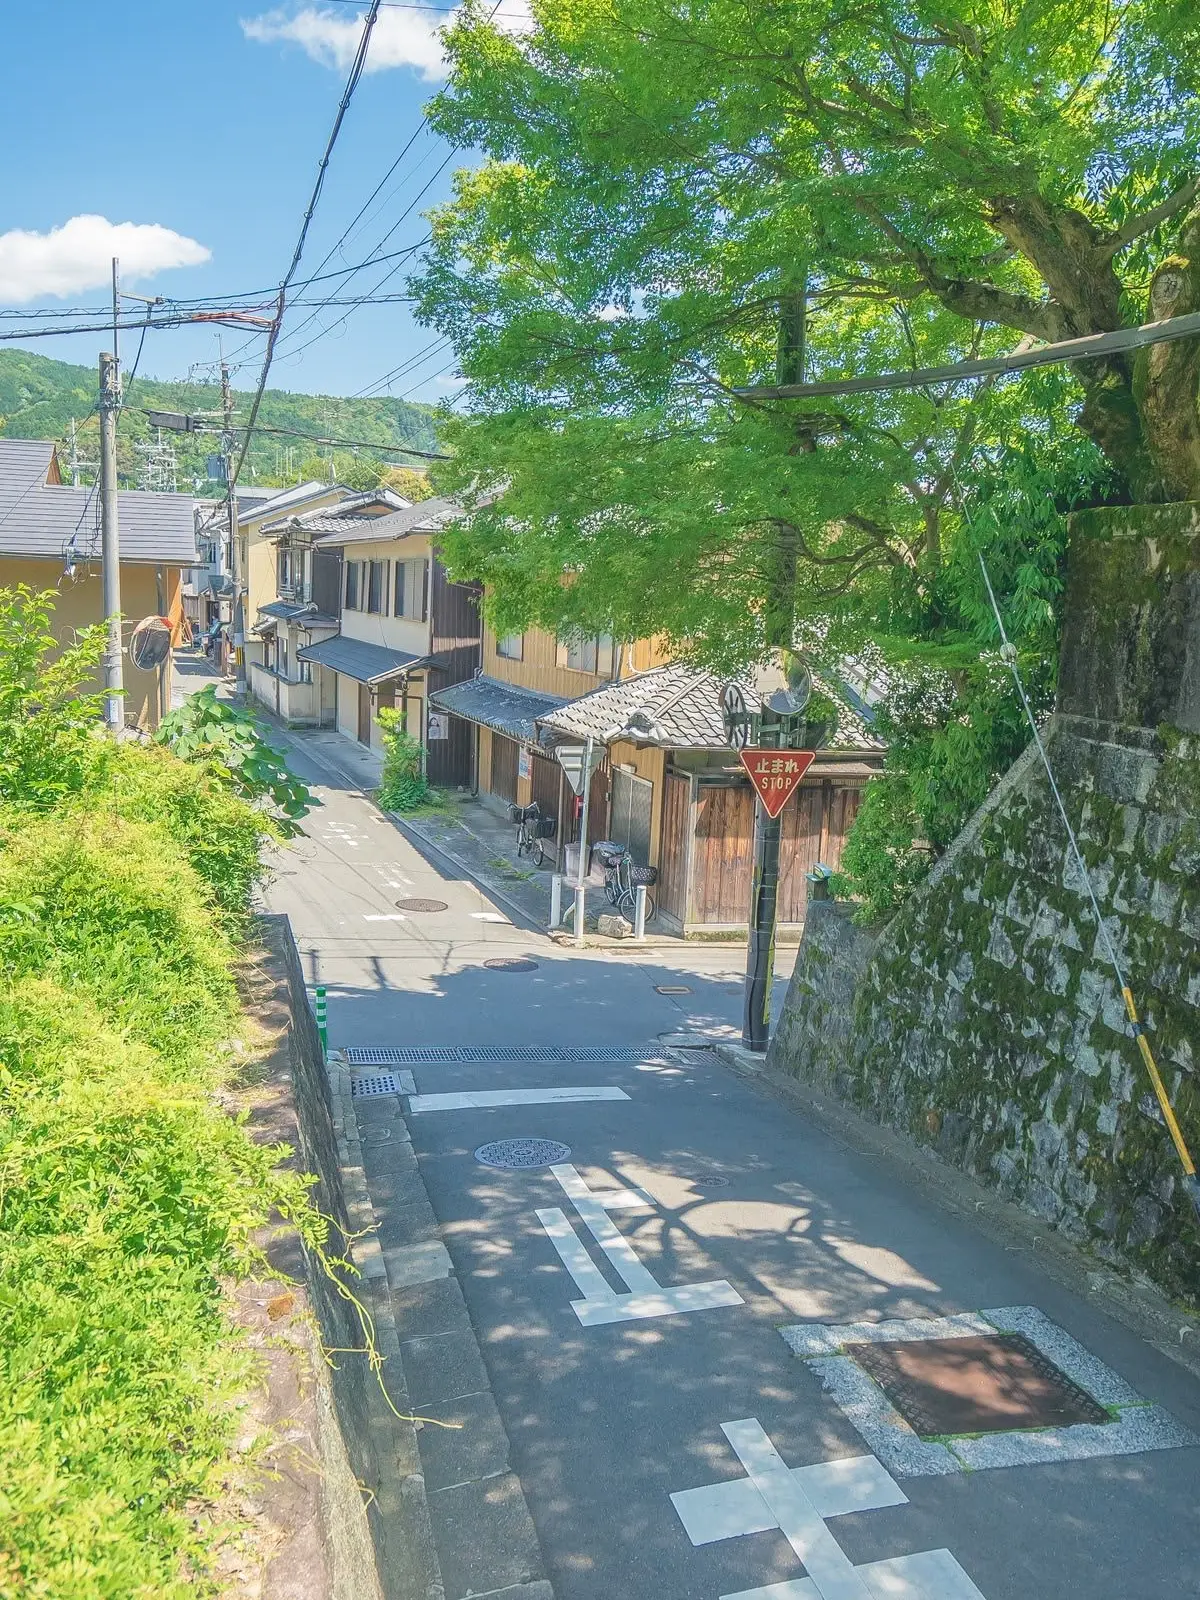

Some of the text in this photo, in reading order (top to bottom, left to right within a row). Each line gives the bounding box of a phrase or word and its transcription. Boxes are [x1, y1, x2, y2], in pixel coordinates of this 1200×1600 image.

[754, 758, 799, 774] 止まれ
[761, 777, 792, 790] STOP
